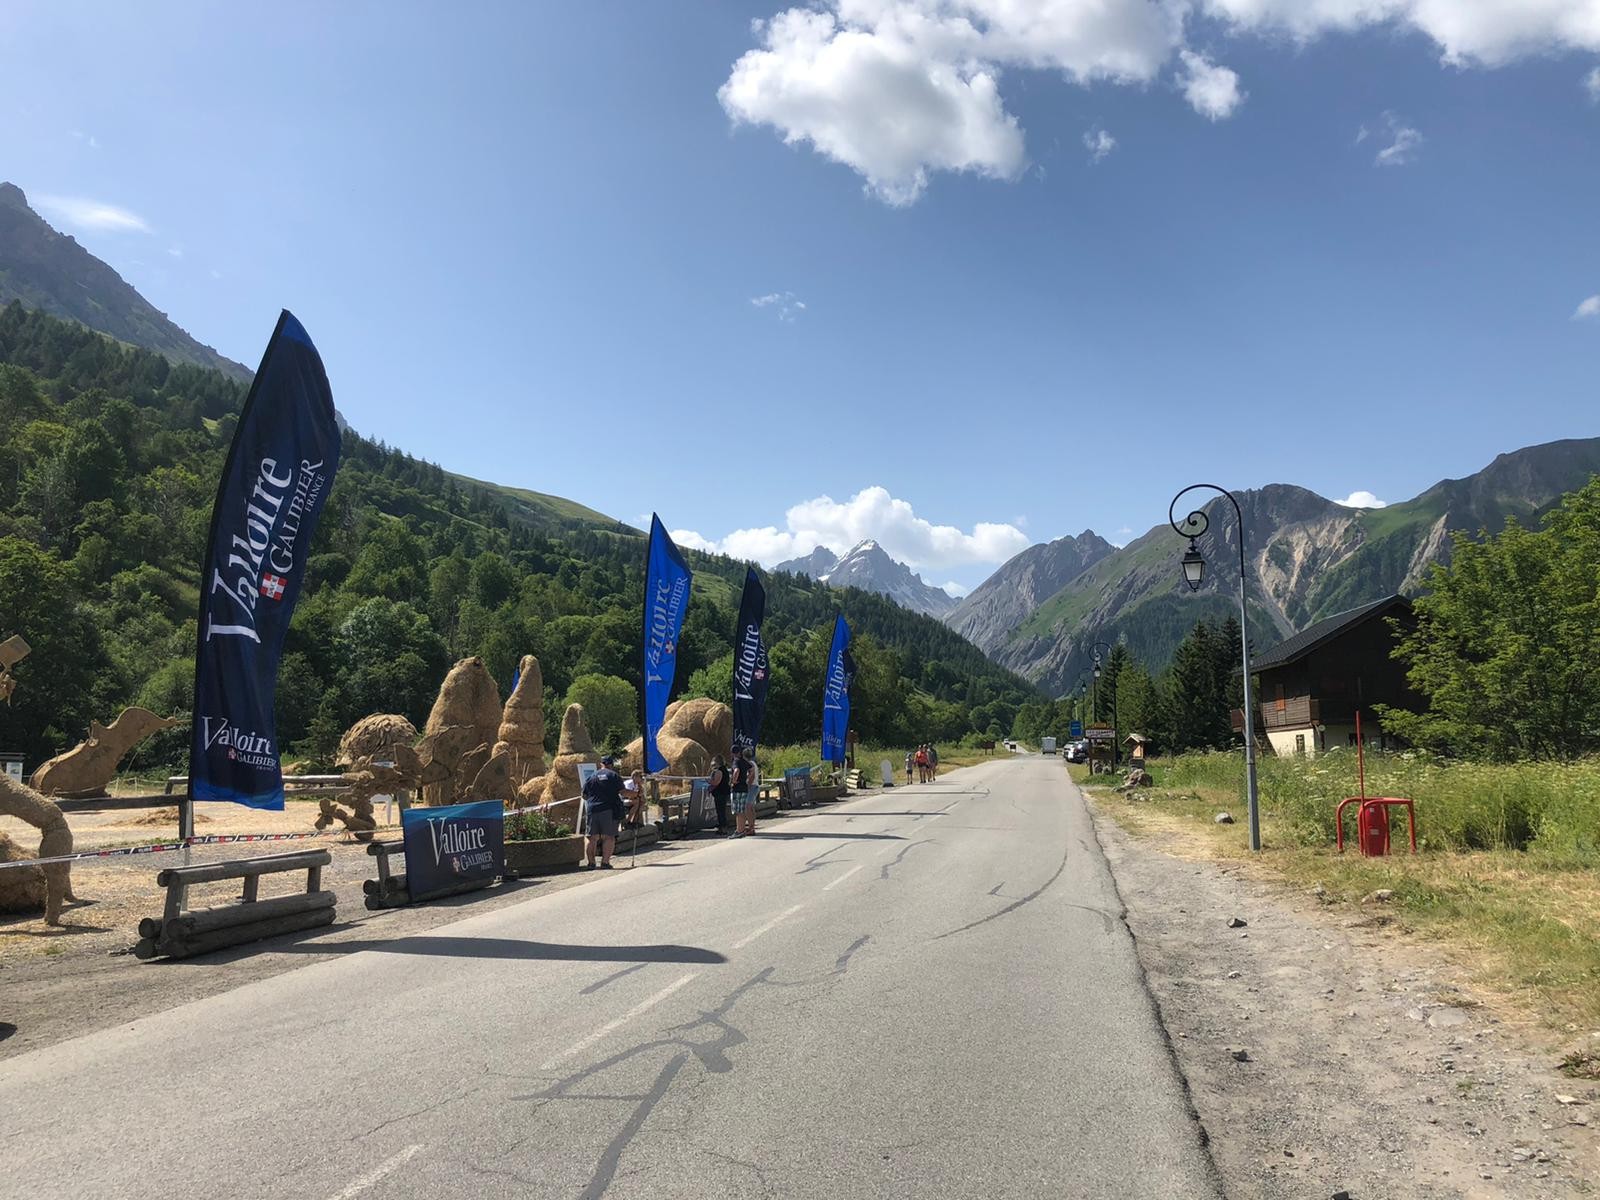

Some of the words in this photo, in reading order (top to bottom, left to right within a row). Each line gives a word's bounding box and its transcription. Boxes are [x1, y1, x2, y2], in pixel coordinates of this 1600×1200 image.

[270, 459, 324, 574] GALIBIER
[304, 473, 326, 513] FRANCE
[205, 456, 293, 644] Valloire
[735, 624, 759, 701] Valloire
[427, 816, 487, 867] Valloire
[460, 850, 494, 871] GALIBIER
